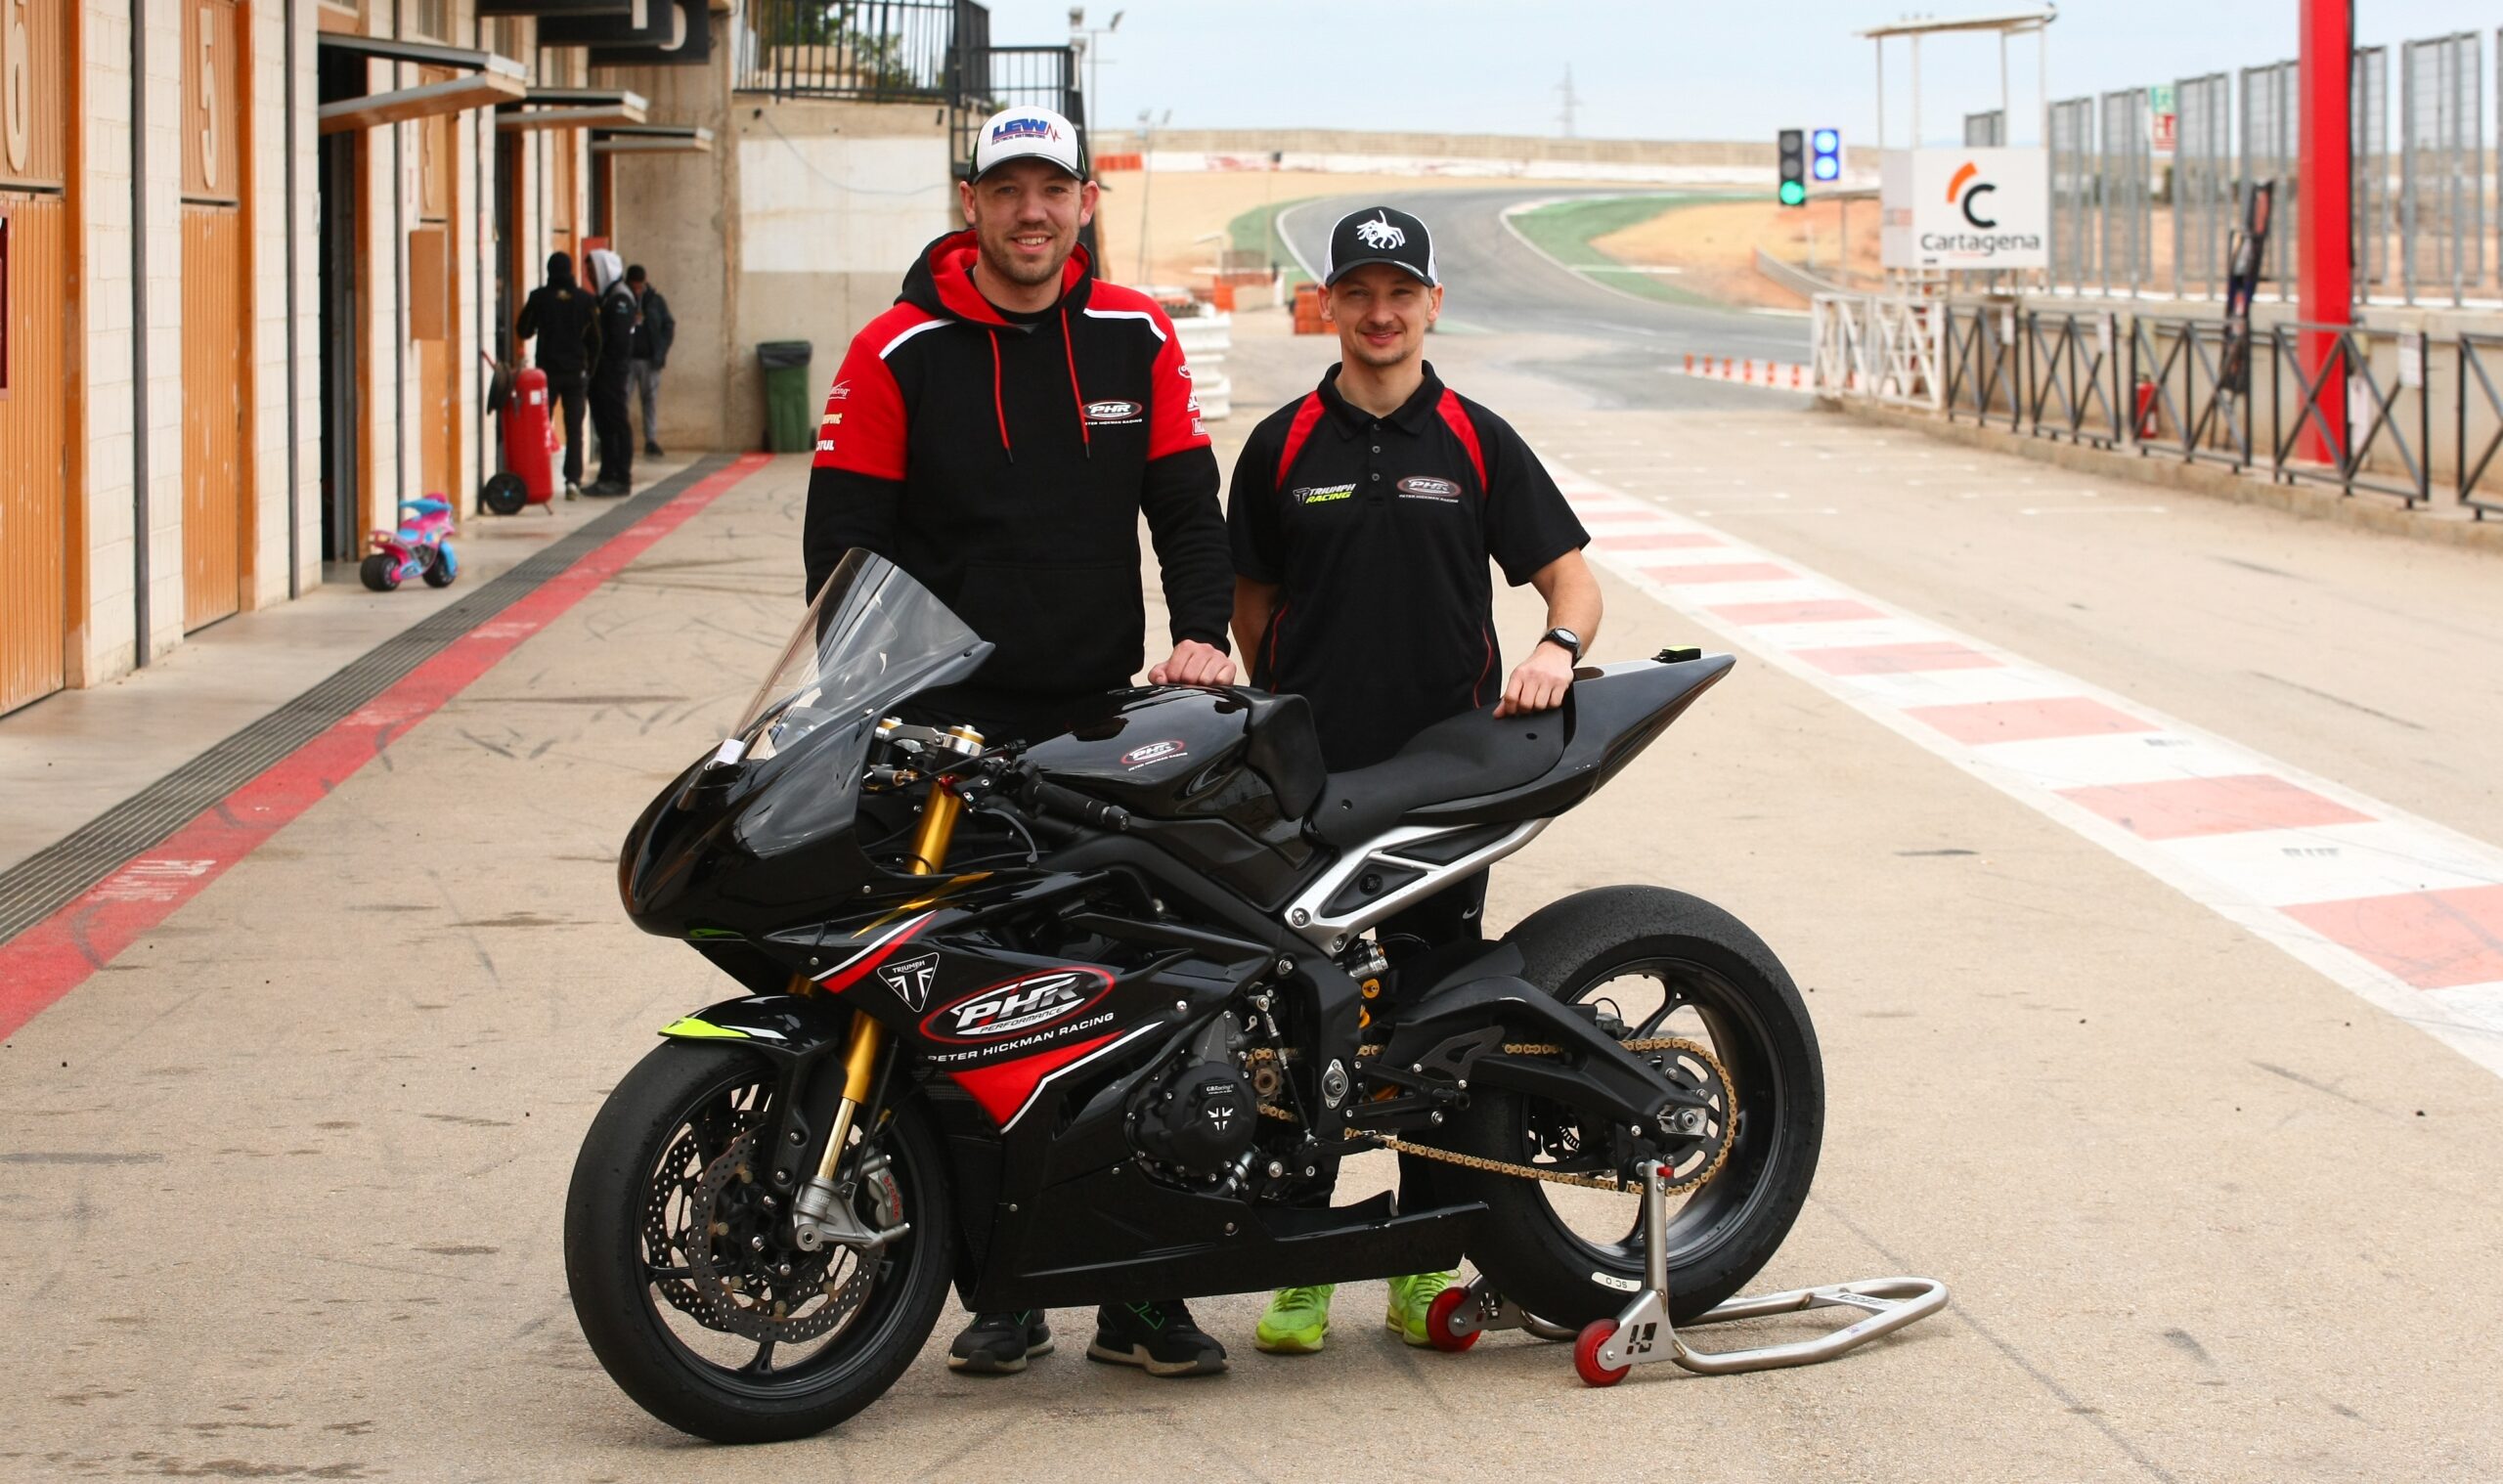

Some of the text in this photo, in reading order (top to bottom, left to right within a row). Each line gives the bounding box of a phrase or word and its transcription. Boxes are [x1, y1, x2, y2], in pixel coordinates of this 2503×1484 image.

[199, 8, 218, 189] 5
[992, 118, 1047, 137] LEW
[1920, 232, 2042, 257] Cartagena
[1090, 405, 1131, 414] PHR
[1309, 483, 1357, 496] TRIUMPH
[1409, 480, 1449, 492] PHR
[1305, 491, 1352, 503] RACING
[1132, 744, 1171, 759] PHR
[892, 960, 926, 975] TRIUMPH
[955, 977, 1079, 1028] PHR
[980, 1006, 1064, 1033] PERFORMANCE
[928, 1012, 1115, 1063] PETER HICKMAN RACING
[883, 1176, 900, 1220] brembo
